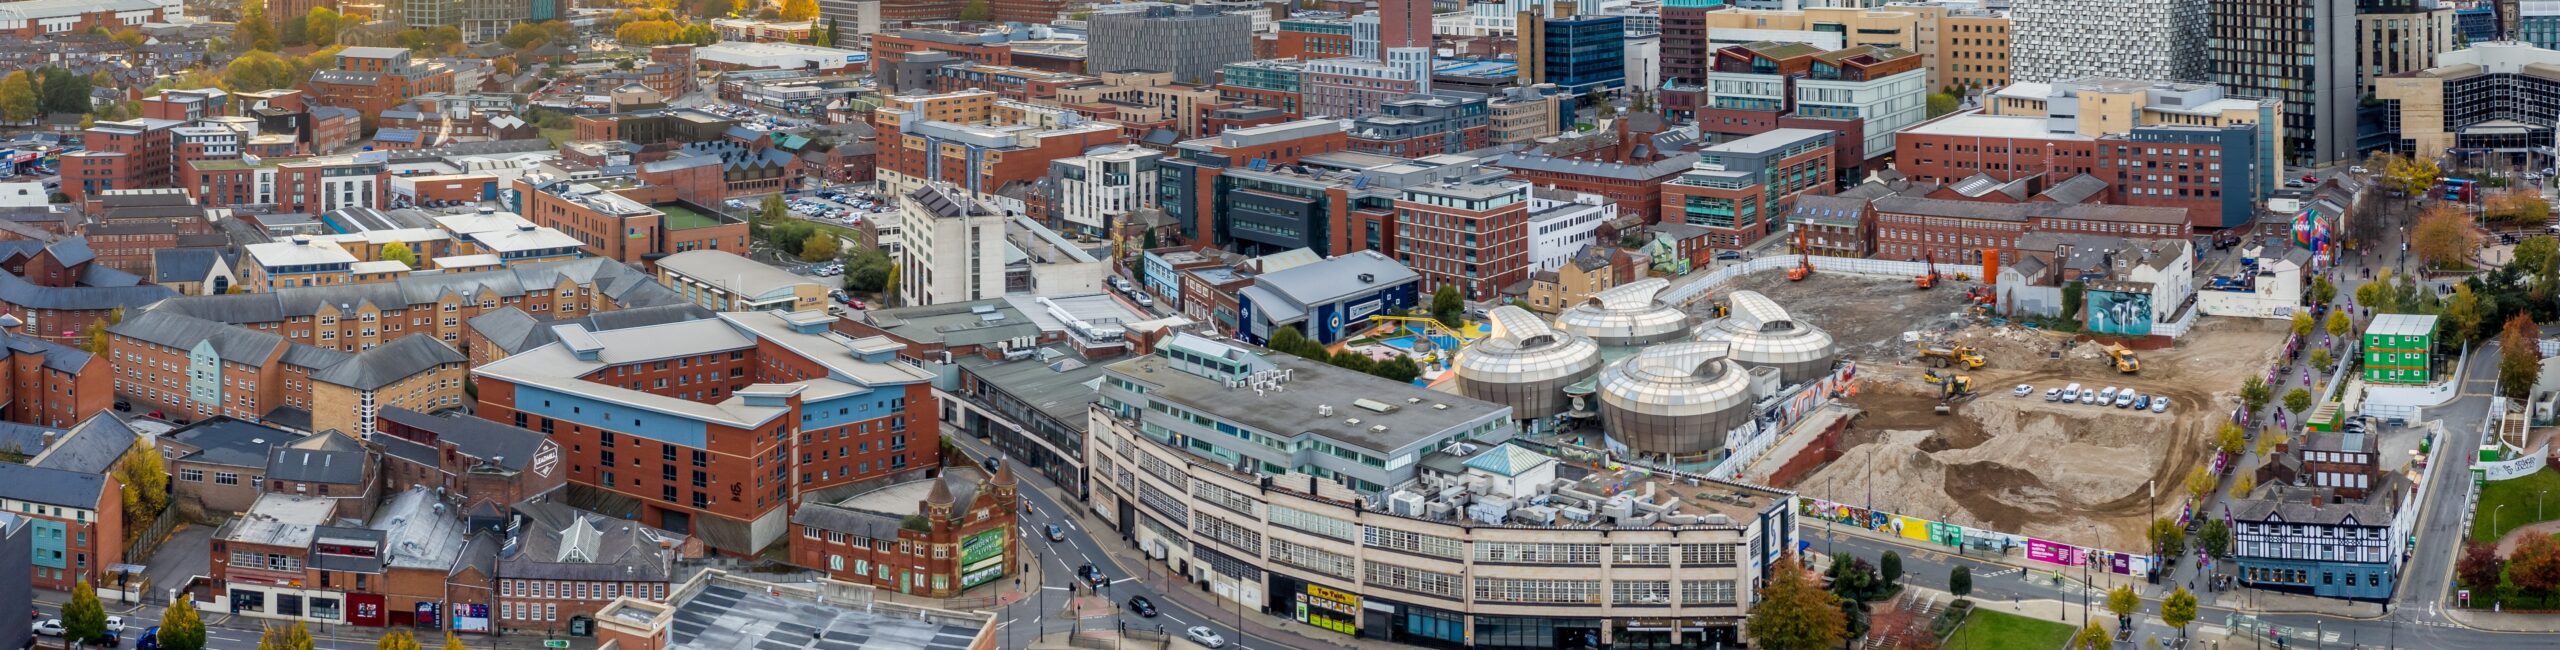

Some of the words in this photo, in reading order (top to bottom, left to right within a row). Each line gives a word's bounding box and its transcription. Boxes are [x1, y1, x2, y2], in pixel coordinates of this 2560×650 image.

[2292, 222, 2310, 231] NOW
[968, 536, 992, 552] STUDENT
[978, 543, 997, 556] LIVING
